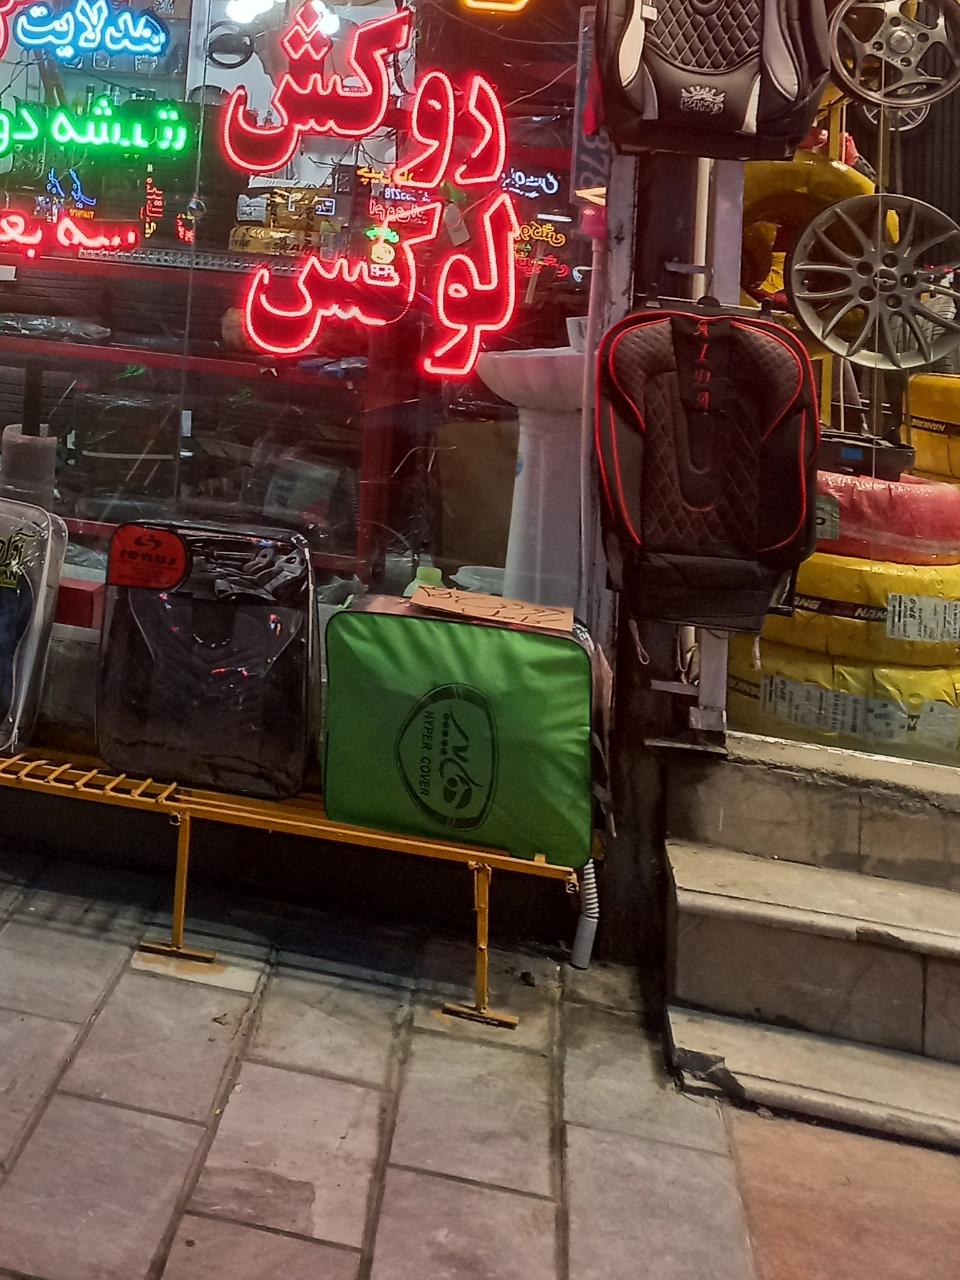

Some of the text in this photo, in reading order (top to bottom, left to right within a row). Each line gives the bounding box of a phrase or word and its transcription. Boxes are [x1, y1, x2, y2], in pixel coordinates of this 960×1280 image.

[222, 0, 506, 189] روکش
[245, 193, 516, 376] لوکس
[418, 709, 435, 797] HYPER COVER
